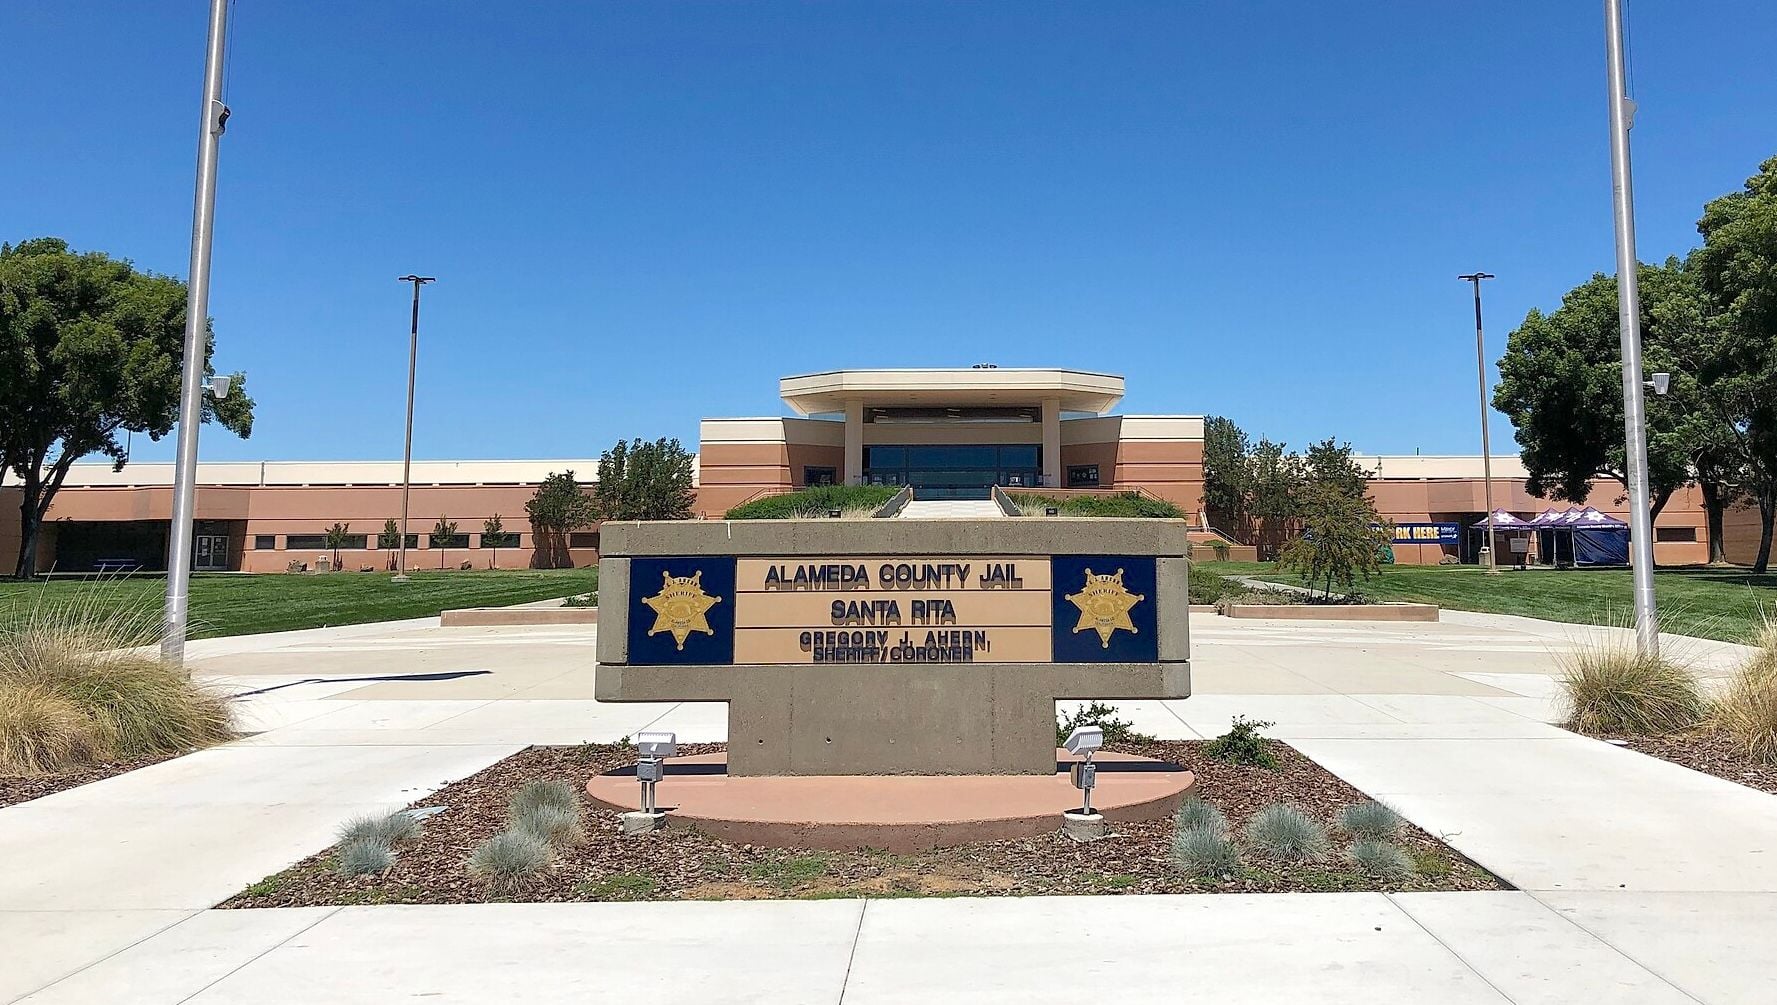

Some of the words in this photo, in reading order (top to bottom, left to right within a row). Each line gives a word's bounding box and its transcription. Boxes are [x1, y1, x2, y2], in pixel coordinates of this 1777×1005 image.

[1413, 526, 1440, 540] HERE
[765, 564, 869, 584] ALAMEDA
[879, 563, 970, 583] COUNTY
[980, 563, 1022, 583] JAIL
[831, 599, 901, 619] SANTA
[911, 599, 956, 619] RITA
[800, 630, 888, 646] GREGORY
